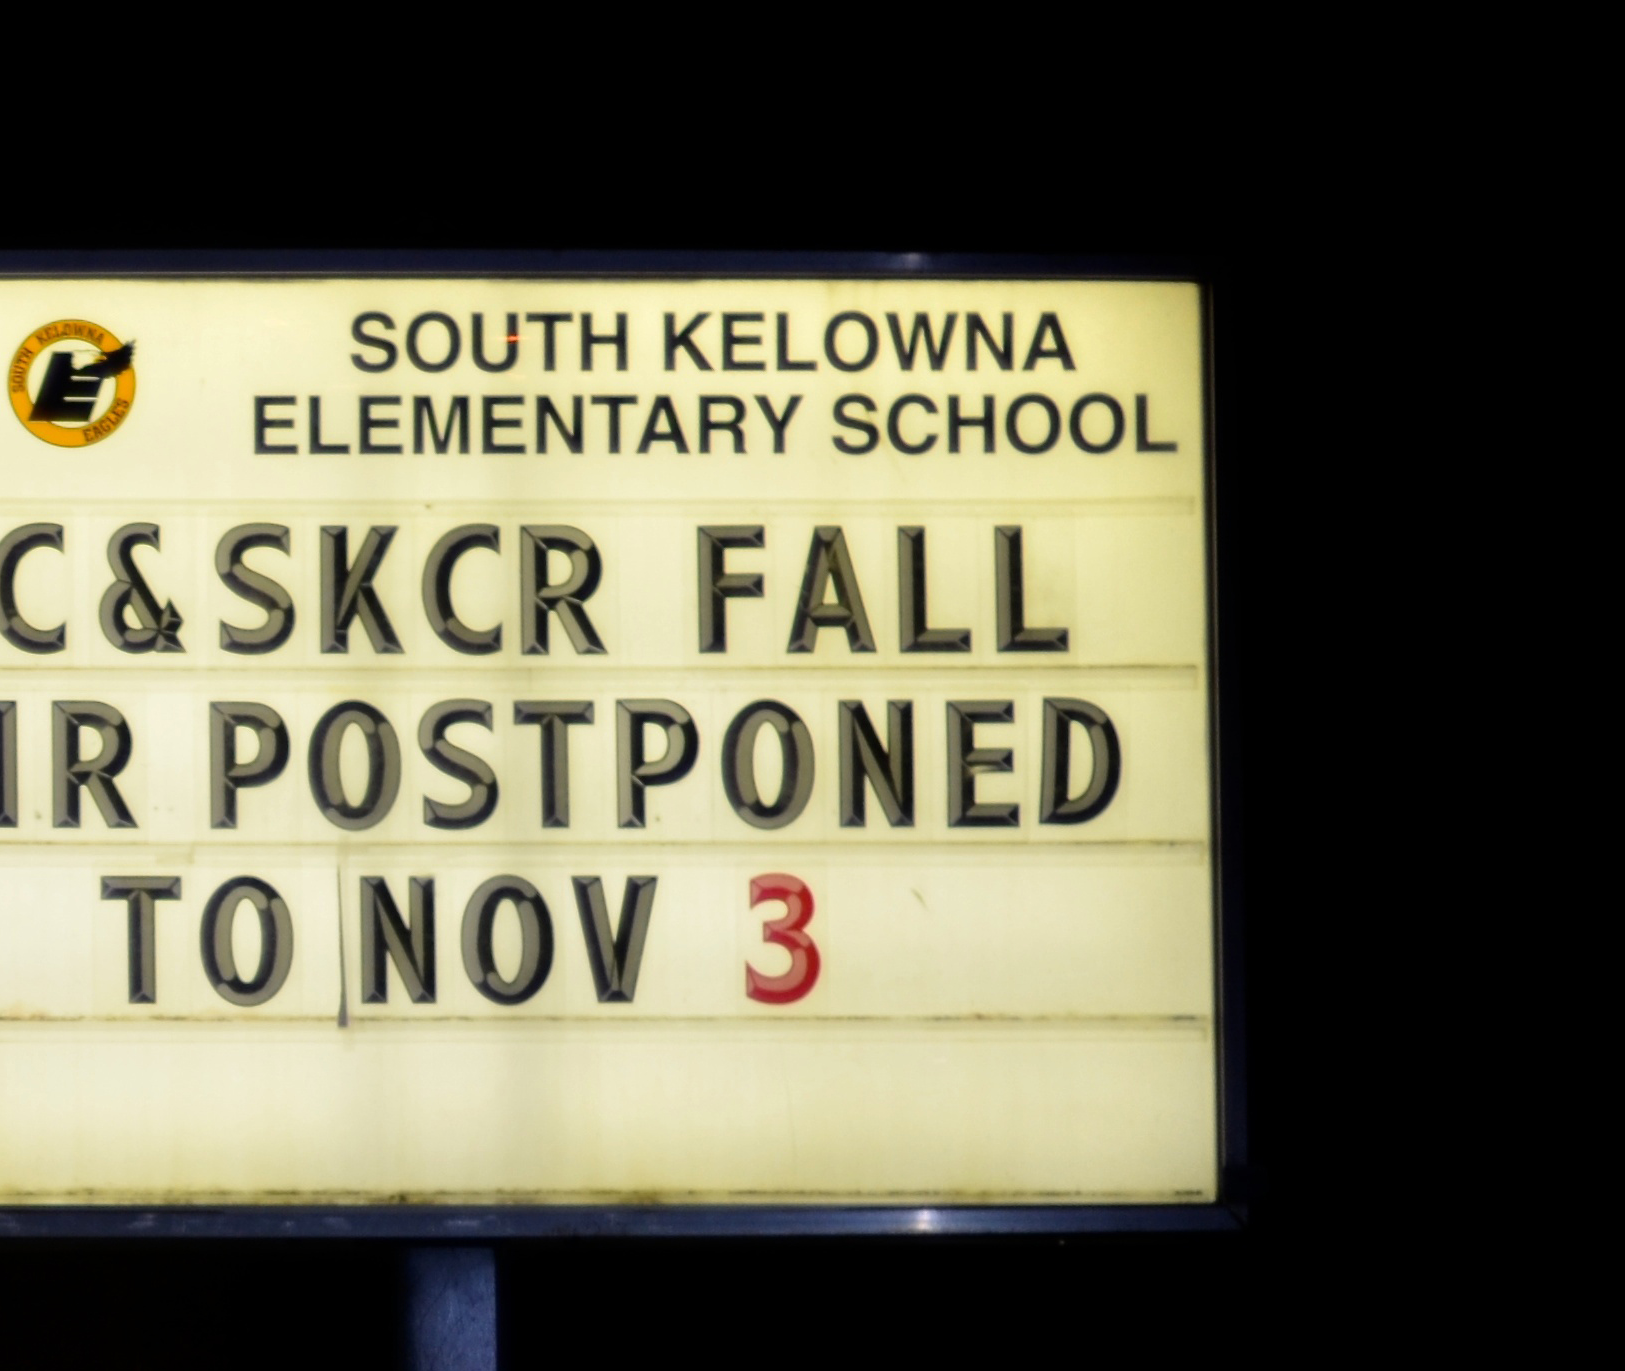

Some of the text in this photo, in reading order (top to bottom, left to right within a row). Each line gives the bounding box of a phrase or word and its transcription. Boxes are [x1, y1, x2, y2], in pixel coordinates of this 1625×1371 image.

[12, 323, 105, 393] SOUTH KELOWNA
[349, 312, 1076, 373] SOUTH KELOWNA
[82, 398, 129, 442] EAGLES
[255, 393, 1178, 455] ELEMENTARY SCHOOL
[698, 525, 1070, 655] FALL
[210, 698, 1123, 830] POSTPONED
[100, 873, 823, 1006] TO NOV 3
